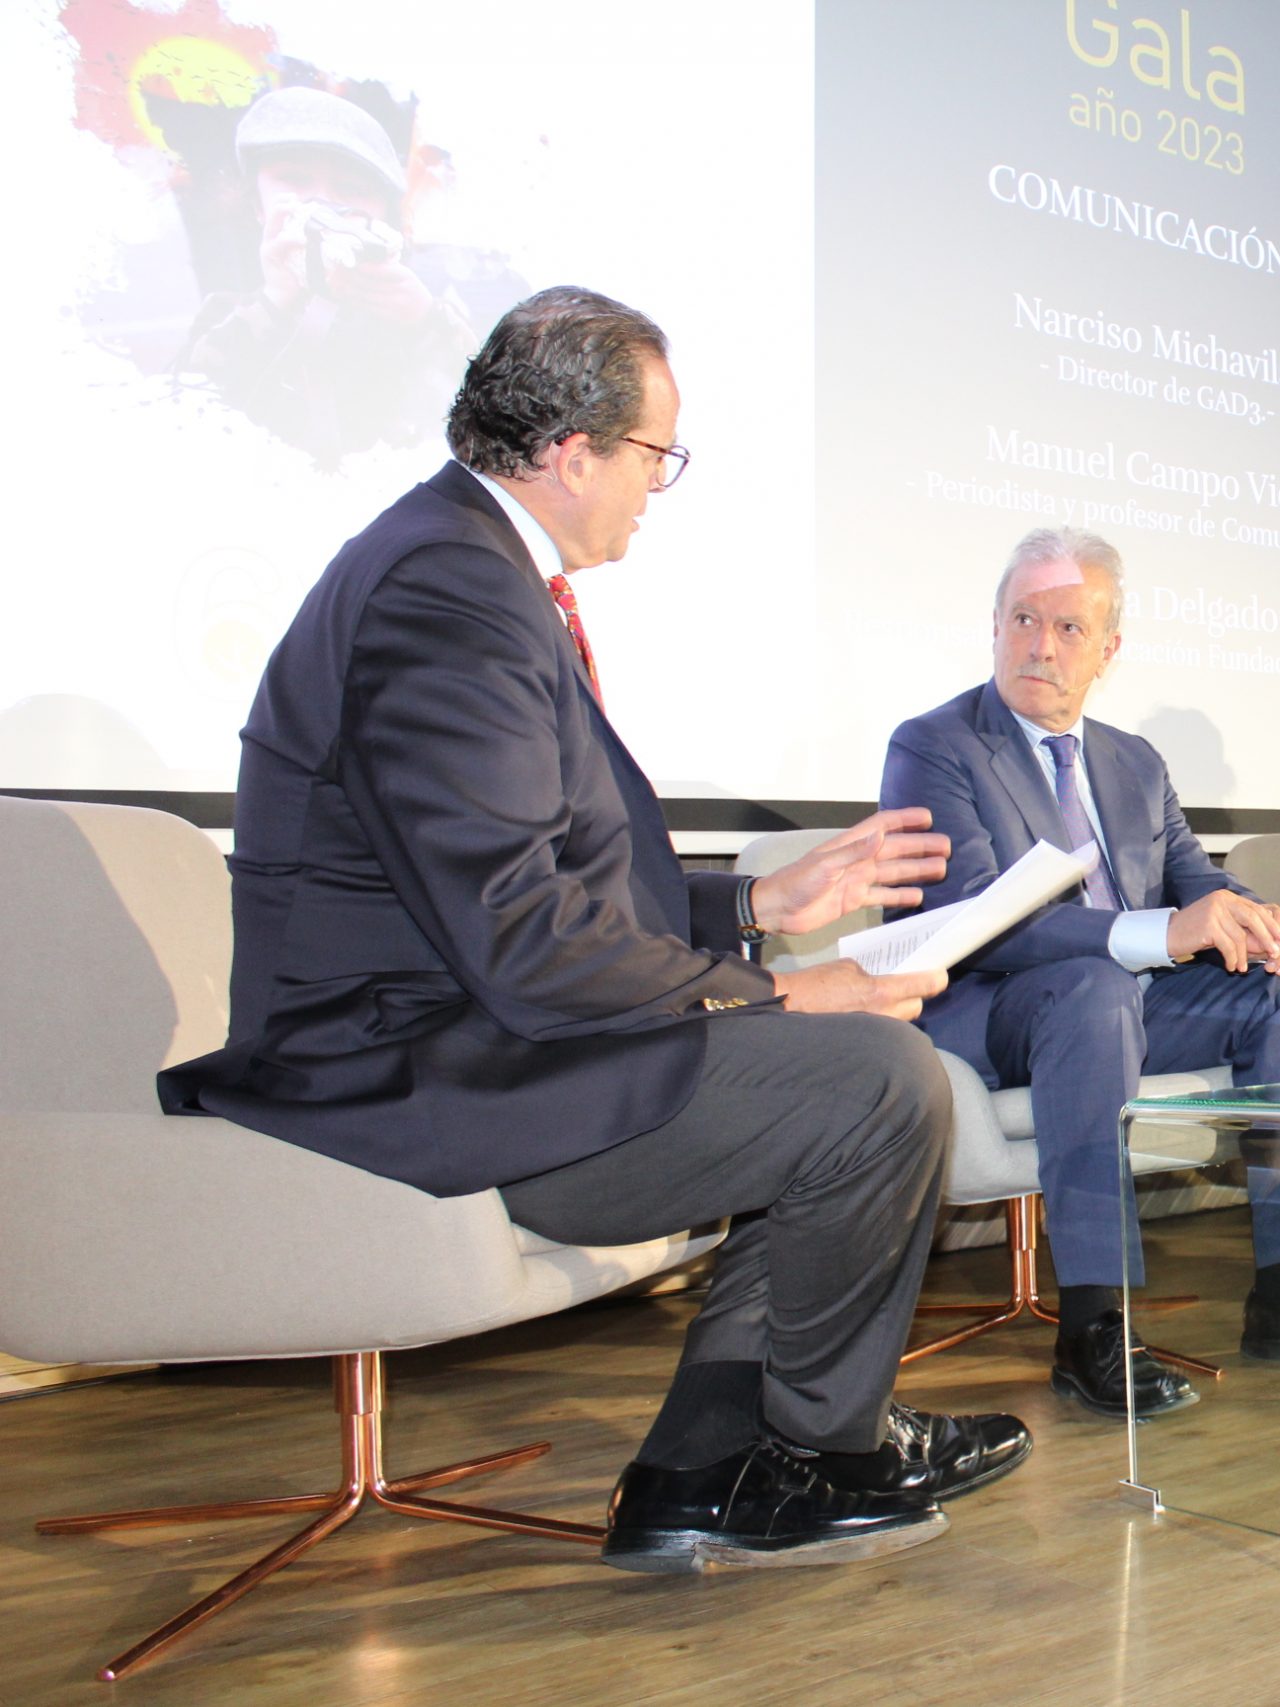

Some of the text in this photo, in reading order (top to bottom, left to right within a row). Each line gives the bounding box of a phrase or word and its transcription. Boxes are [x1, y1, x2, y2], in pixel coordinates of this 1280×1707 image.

[1066, 0, 1246, 116] Gala
[1068, 86, 1245, 176] año 2023
[1012, 292, 1143, 353] Narciso
[1056, 354, 1159, 399] Director
[1162, 376, 1191, 406] de
[985, 425, 1117, 481] Manuel
[1126, 451, 1240, 508] Campo
[924, 470, 1056, 516] Periodista
[1060, 496, 1077, 525] y
[1081, 498, 1184, 533] profesor
[1187, 509, 1216, 539] de
[1151, 586, 1279, 638] Delgado
